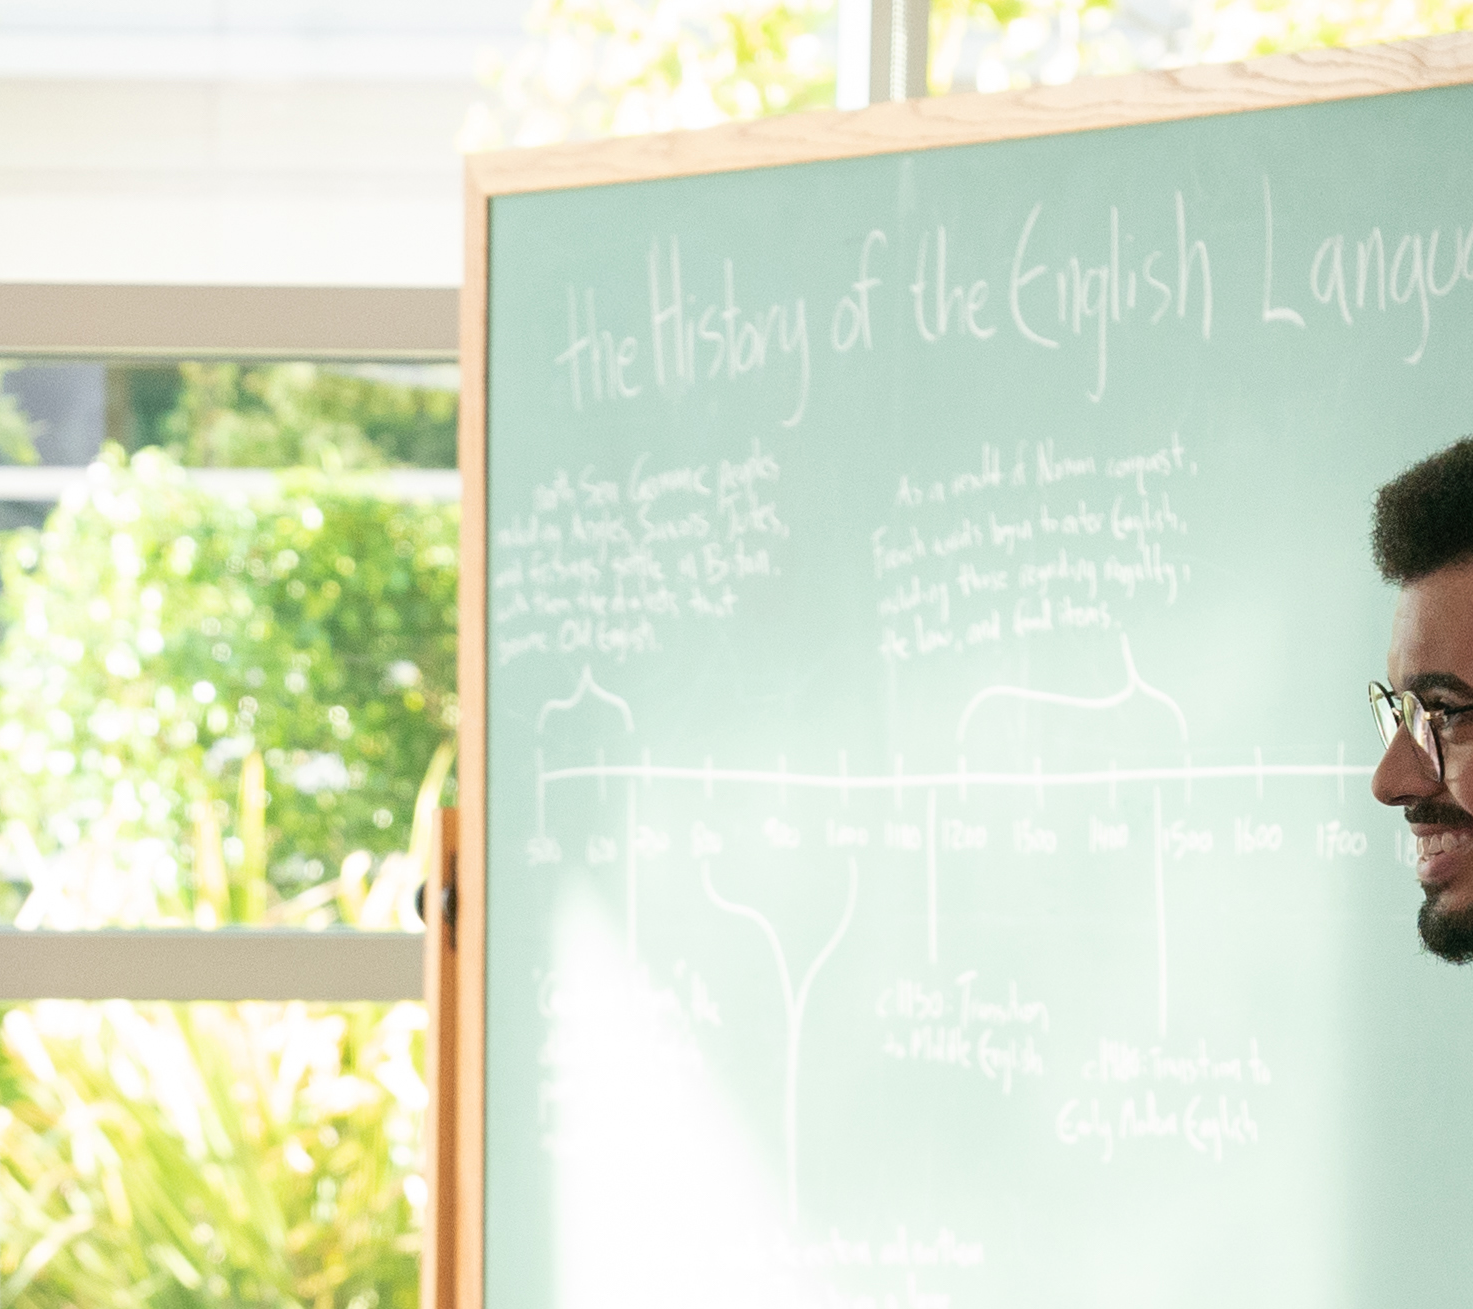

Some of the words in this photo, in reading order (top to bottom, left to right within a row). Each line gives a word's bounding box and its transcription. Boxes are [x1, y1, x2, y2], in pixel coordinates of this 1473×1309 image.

[647, 230, 808, 428] History
[831, 227, 889, 351] of
[909, 223, 997, 343] the
[1008, 188, 1215, 404] English
[1163, 819, 1214, 862] 1500
[1235, 812, 1284, 857] 1600
[1316, 819, 1368, 862] 1700
[1056, 1098, 1115, 1163] Early
[1184, 1094, 1259, 1163] English
